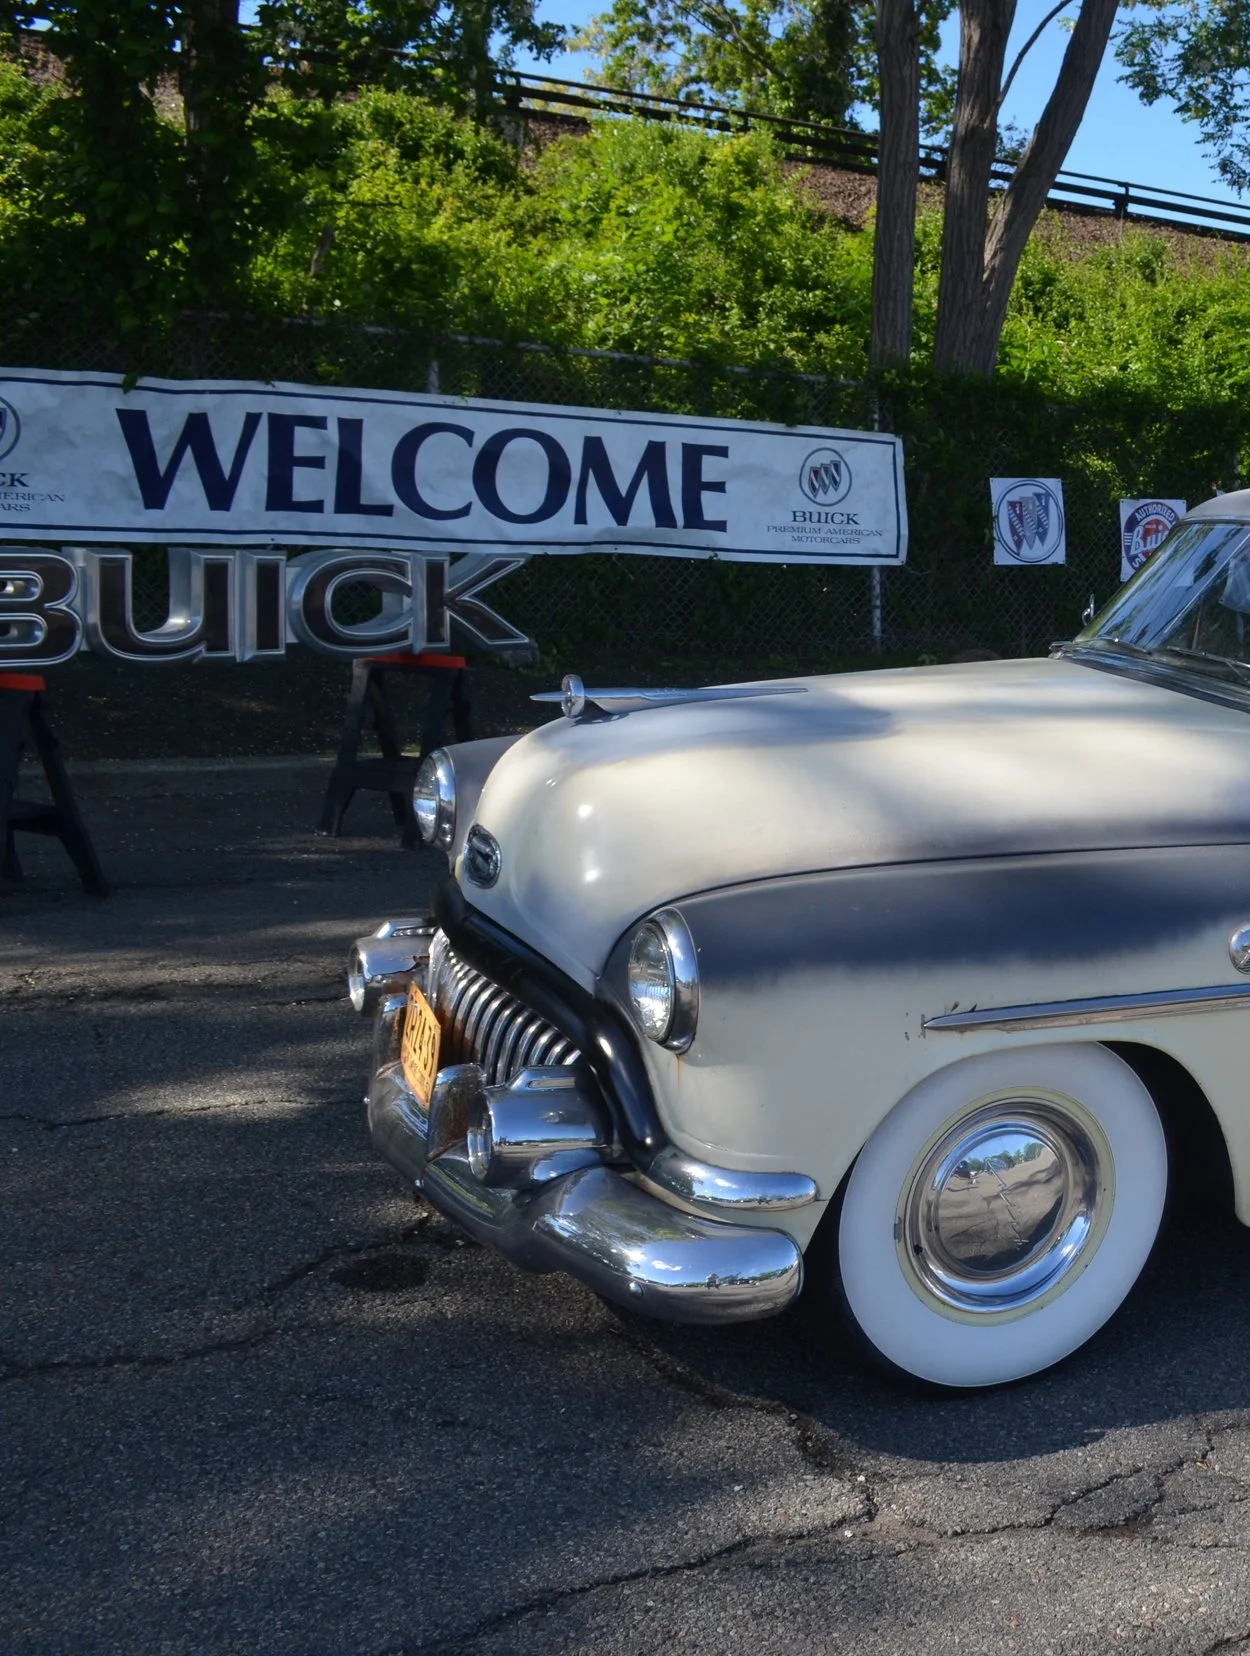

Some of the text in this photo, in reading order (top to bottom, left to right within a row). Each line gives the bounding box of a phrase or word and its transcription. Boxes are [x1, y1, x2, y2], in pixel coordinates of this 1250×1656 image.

[116, 408, 729, 533] WELCOME
[0, 491, 65, 502] ERICAN
[791, 510, 860, 525] BUICK
[1135, 504, 1175, 521] AUTHORIZED
[767, 525, 884, 537] PREMIUM AMERICAN
[791, 535, 860, 545] MOTORCARS
[0, 548, 533, 666] BUICK
